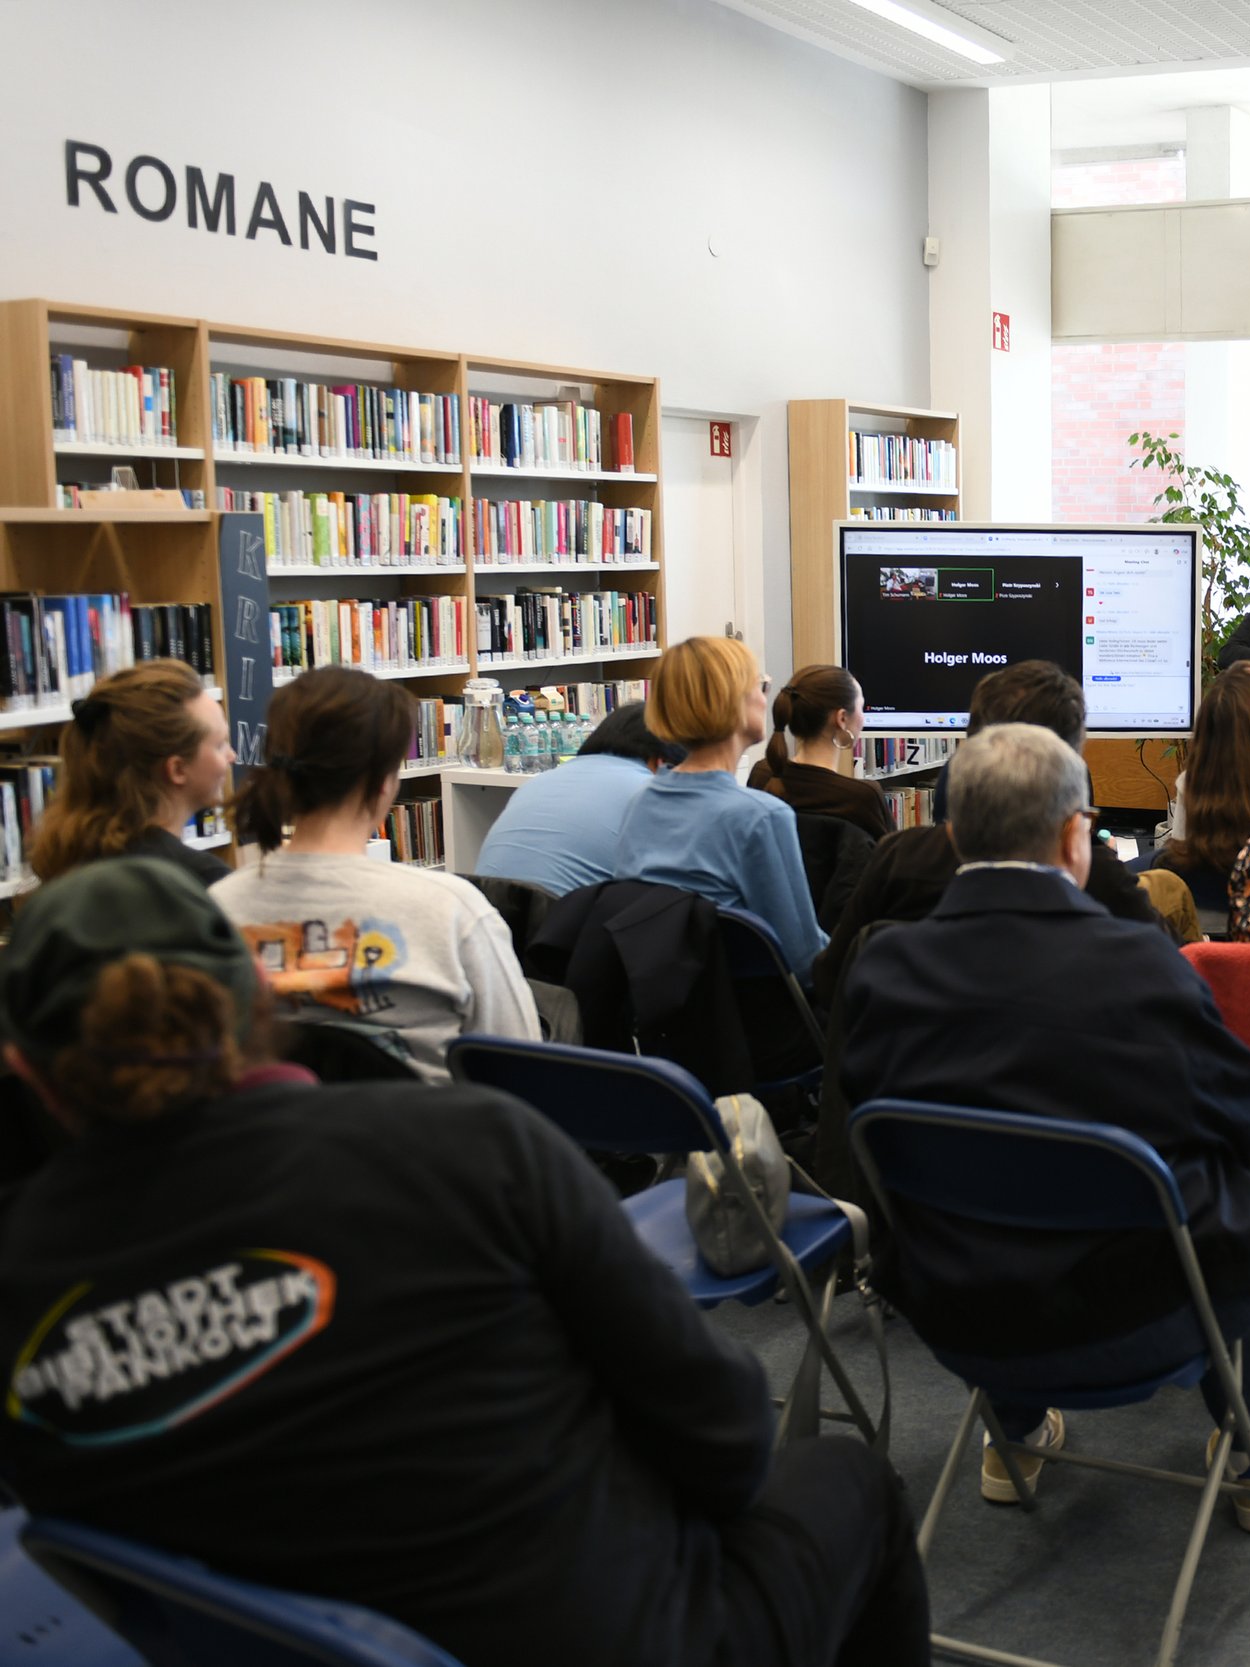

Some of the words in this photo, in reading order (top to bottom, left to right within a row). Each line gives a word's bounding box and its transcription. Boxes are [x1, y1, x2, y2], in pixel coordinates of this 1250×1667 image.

[64, 139, 378, 261] ROMANE
[924, 652, 968, 666] Holger
[972, 652, 1007, 664] Moos
[907, 746, 920, 765] Z
